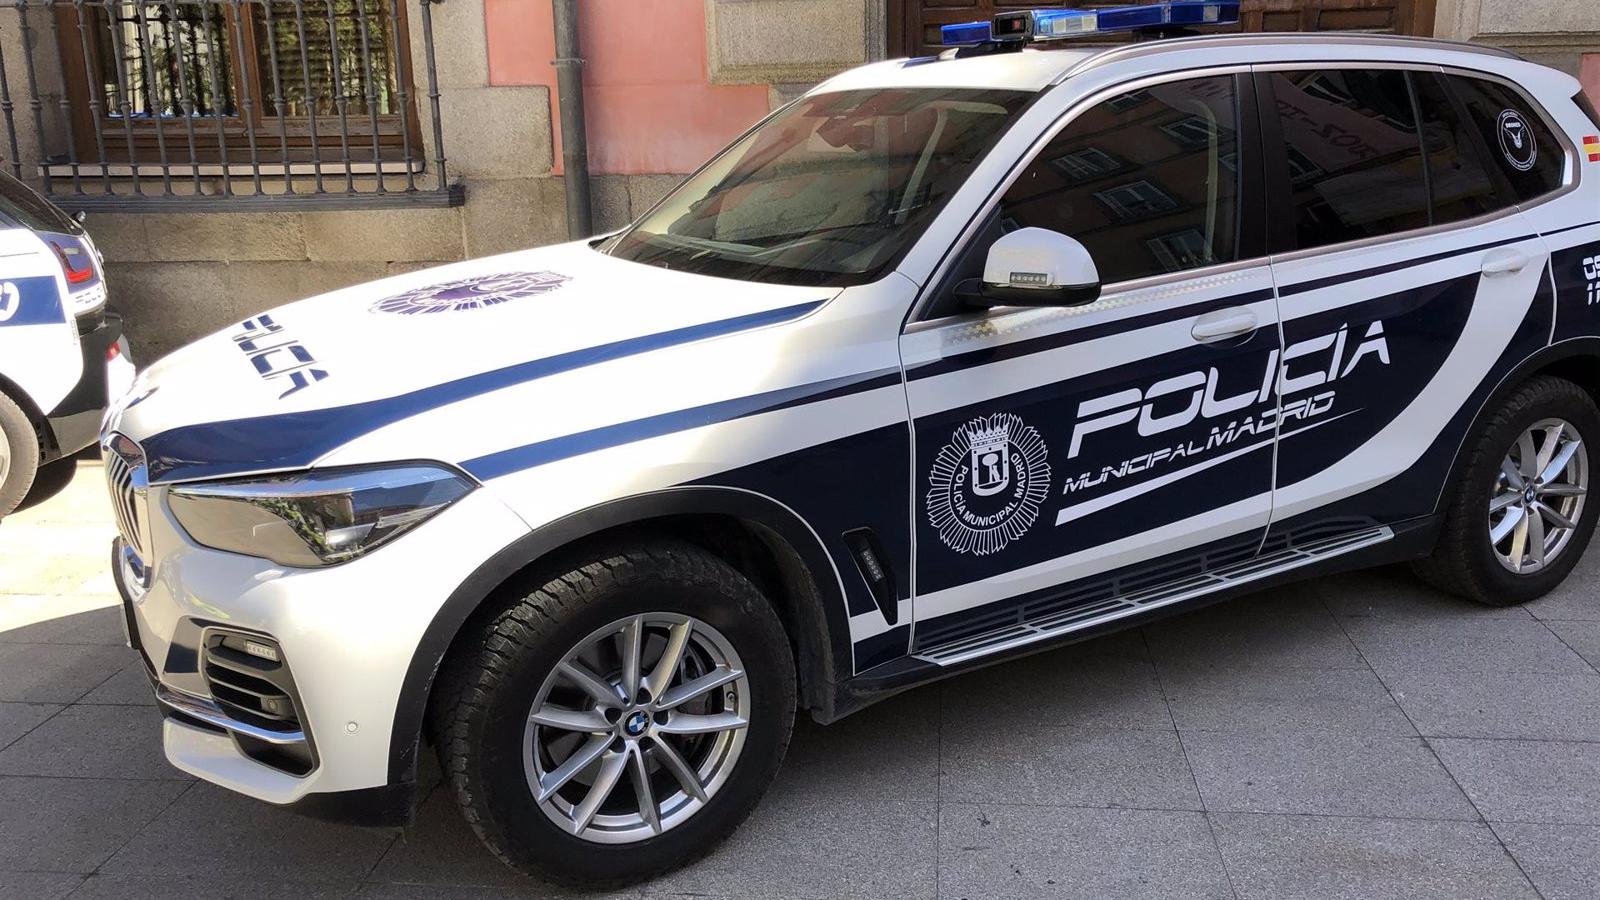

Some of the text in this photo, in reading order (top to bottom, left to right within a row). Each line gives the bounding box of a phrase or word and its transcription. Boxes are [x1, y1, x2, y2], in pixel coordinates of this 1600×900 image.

[1066, 319, 1391, 460] POLICÍA
[962, 501, 1019, 527] MUNICIPAL
[1010, 452, 1027, 499] MADRID
[1062, 390, 1336, 495] MUNICIPAL MADRID
